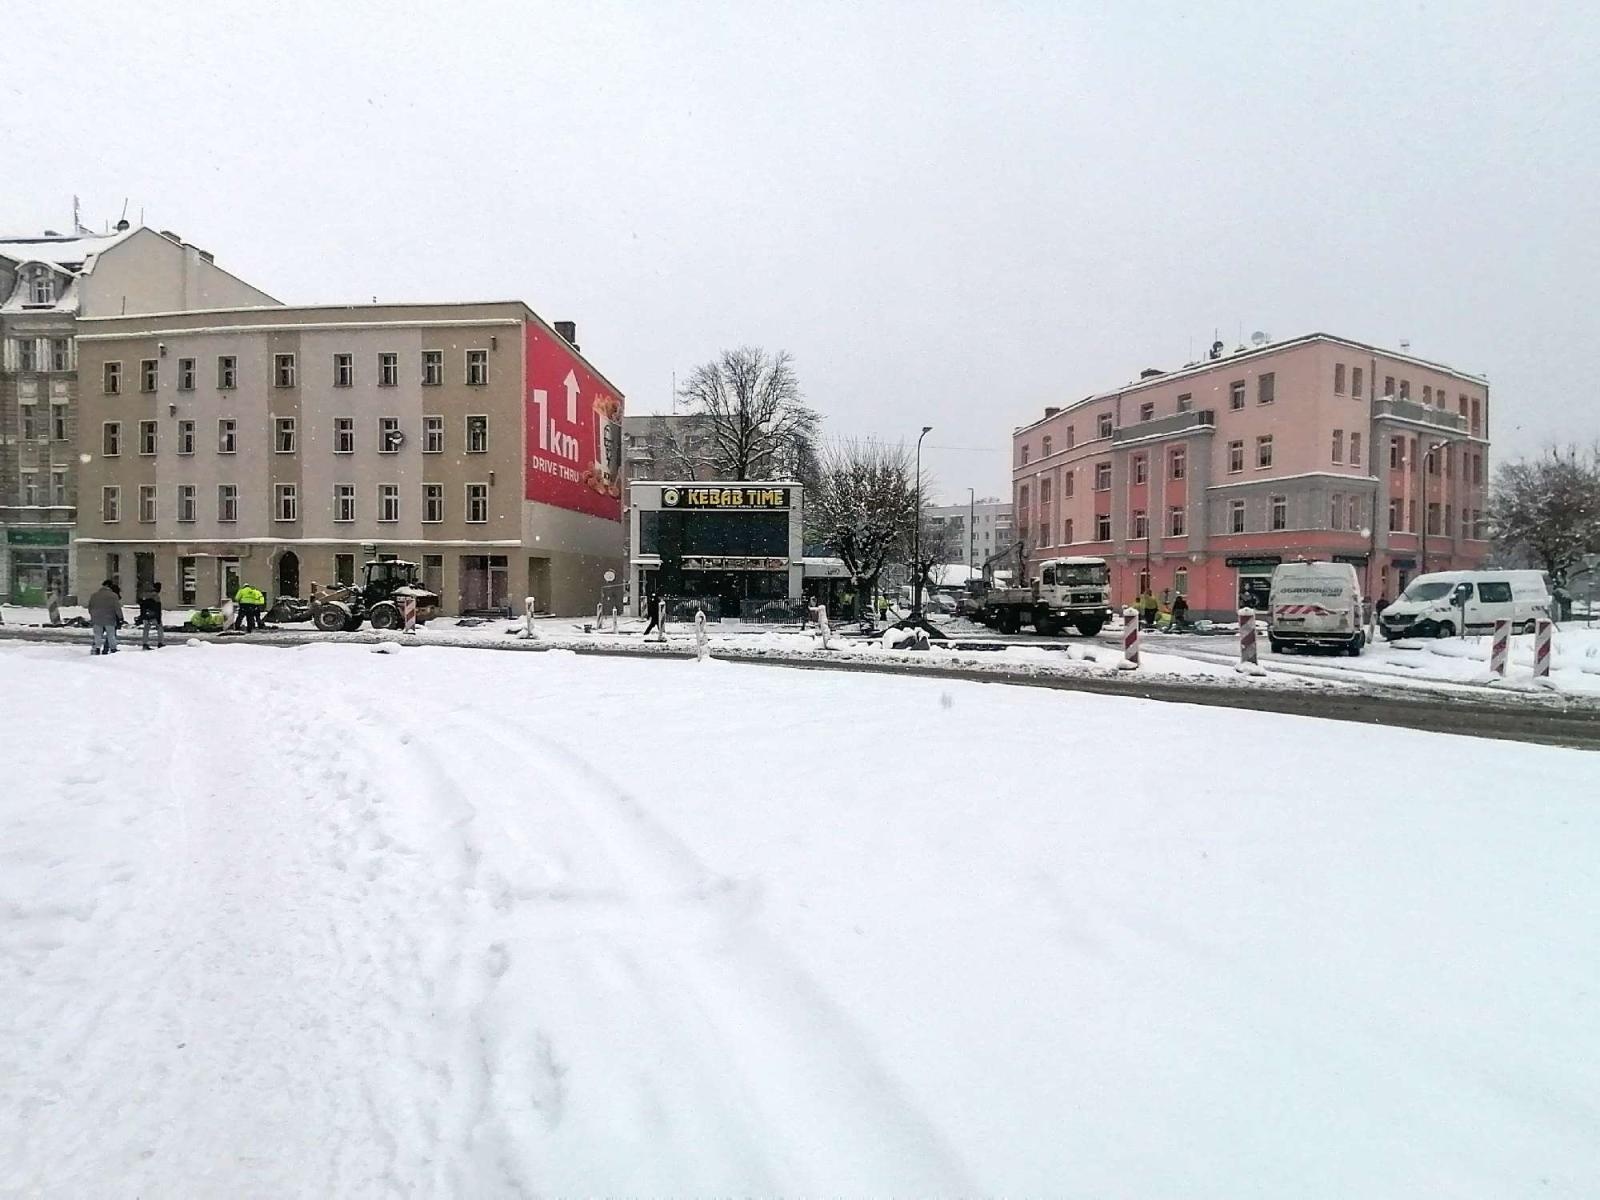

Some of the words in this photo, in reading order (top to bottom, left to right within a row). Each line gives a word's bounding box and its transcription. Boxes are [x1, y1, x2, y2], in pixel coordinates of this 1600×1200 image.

[532, 455, 558, 476] DRIVE
[558, 464, 580, 483] THRU
[688, 488, 743, 505] KEBAB
[746, 489, 784, 506] TIME
